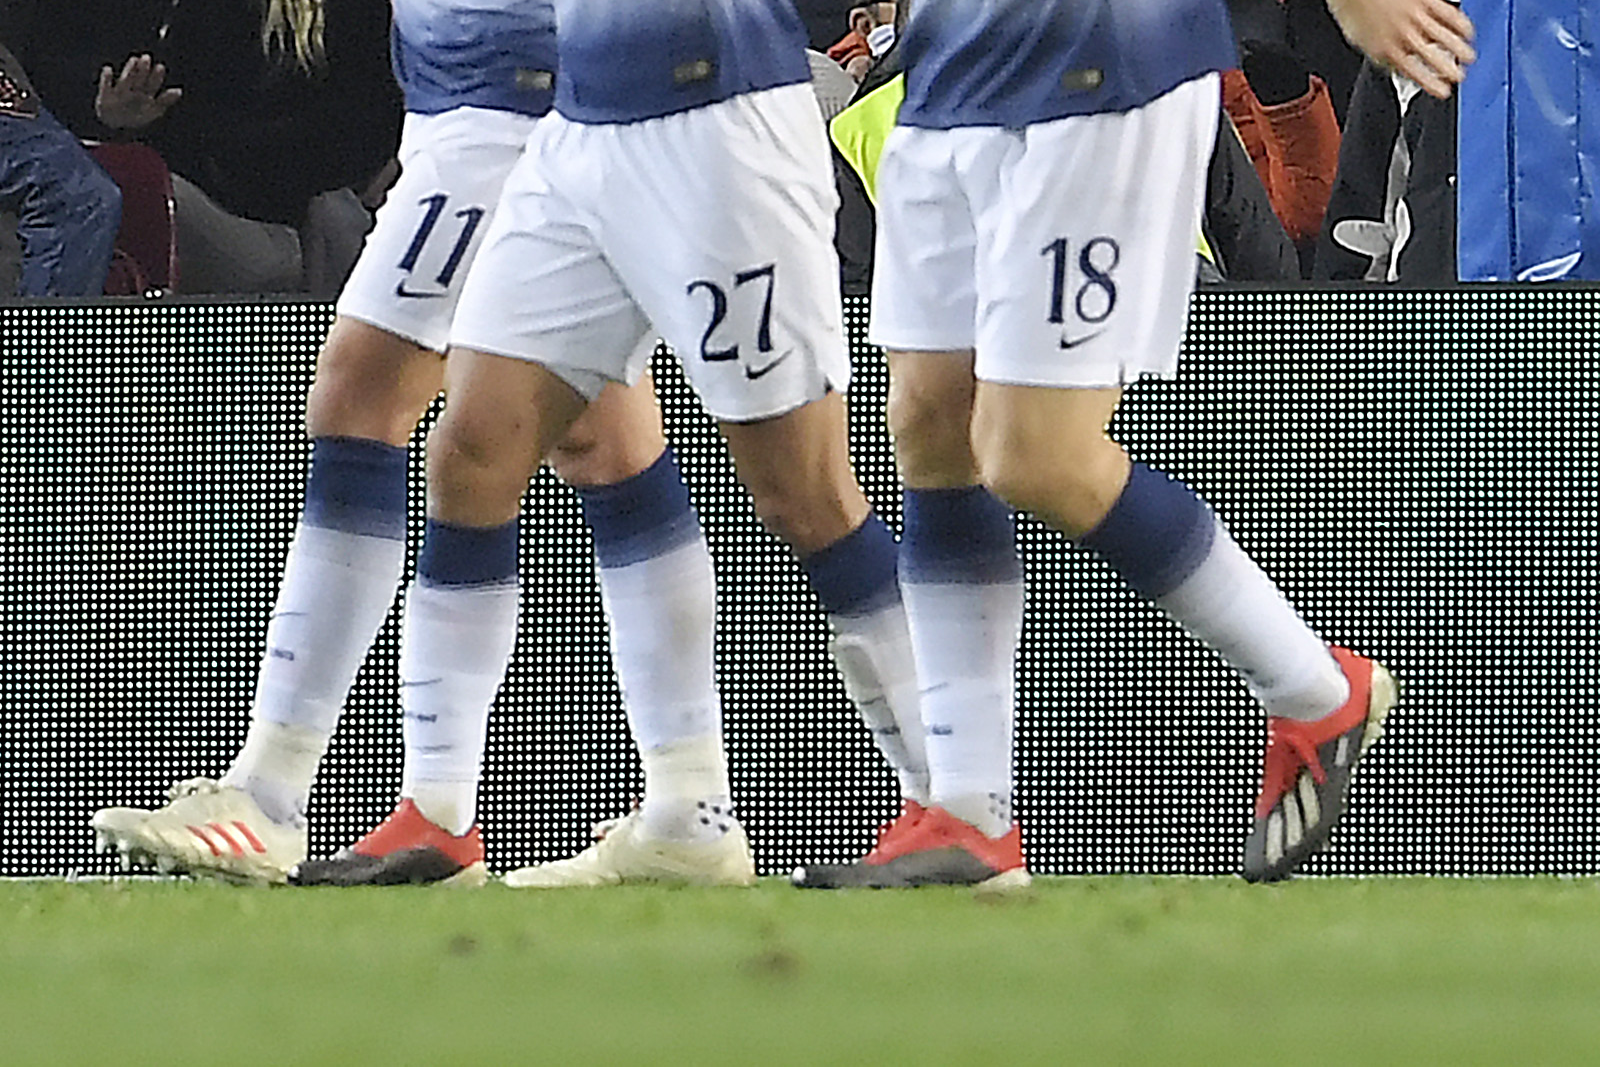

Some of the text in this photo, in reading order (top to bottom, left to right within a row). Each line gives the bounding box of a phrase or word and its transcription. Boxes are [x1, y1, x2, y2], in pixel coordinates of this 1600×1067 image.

[397, 192, 485, 289] 11
[1040, 236, 1120, 324] 18
[686, 263, 776, 363] 27
